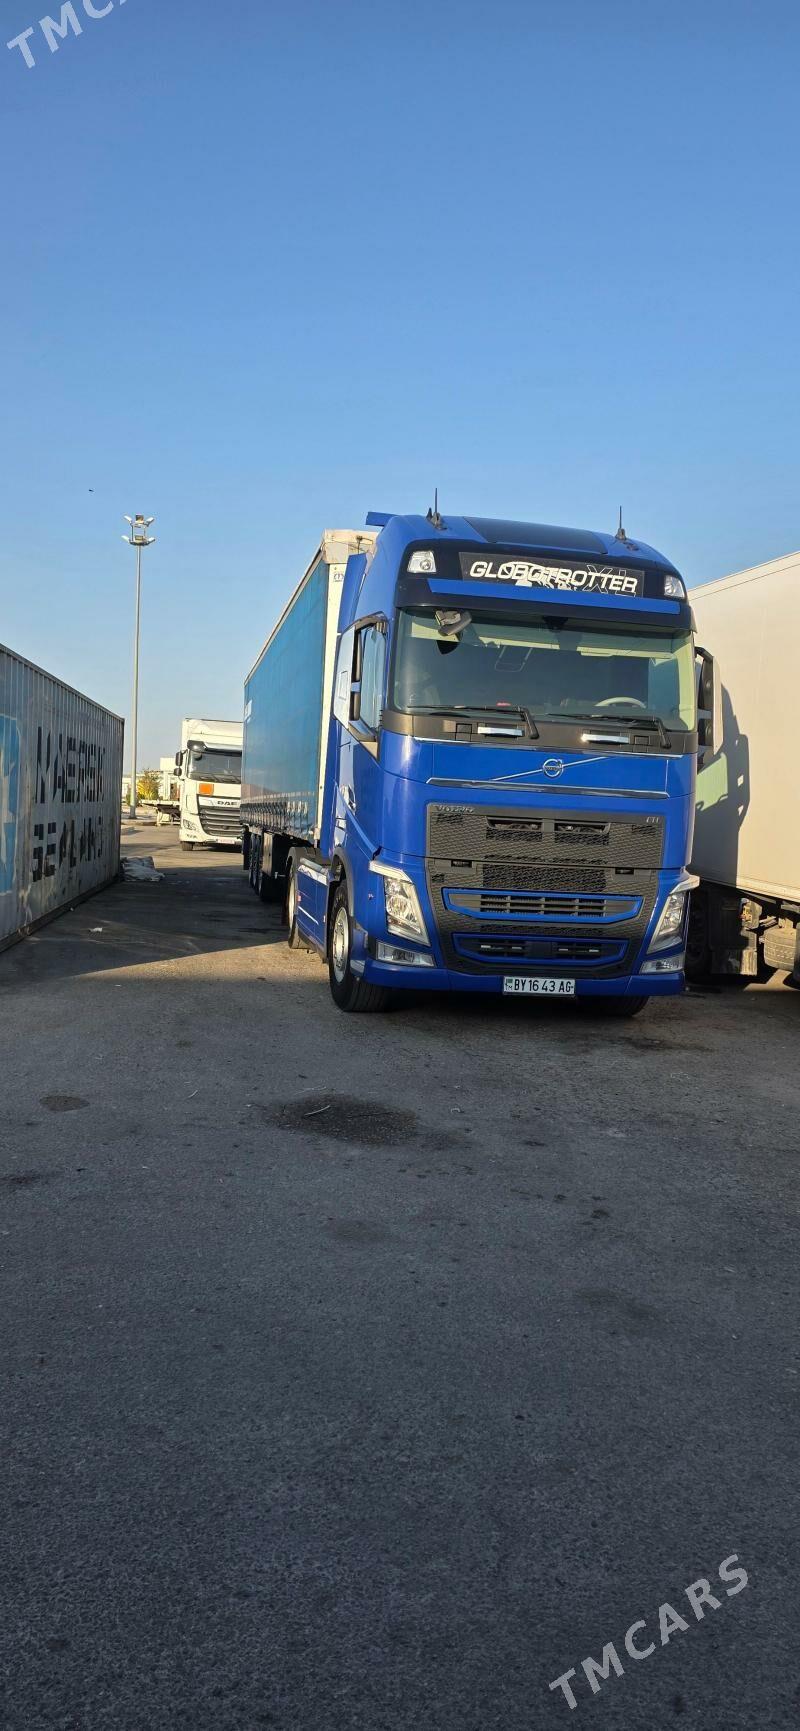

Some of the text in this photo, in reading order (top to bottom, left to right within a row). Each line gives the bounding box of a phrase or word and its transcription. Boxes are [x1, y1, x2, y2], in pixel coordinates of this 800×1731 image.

[514, 979, 526, 991] BY
[528, 979, 540, 992] 16
[541, 980, 556, 992] 43
